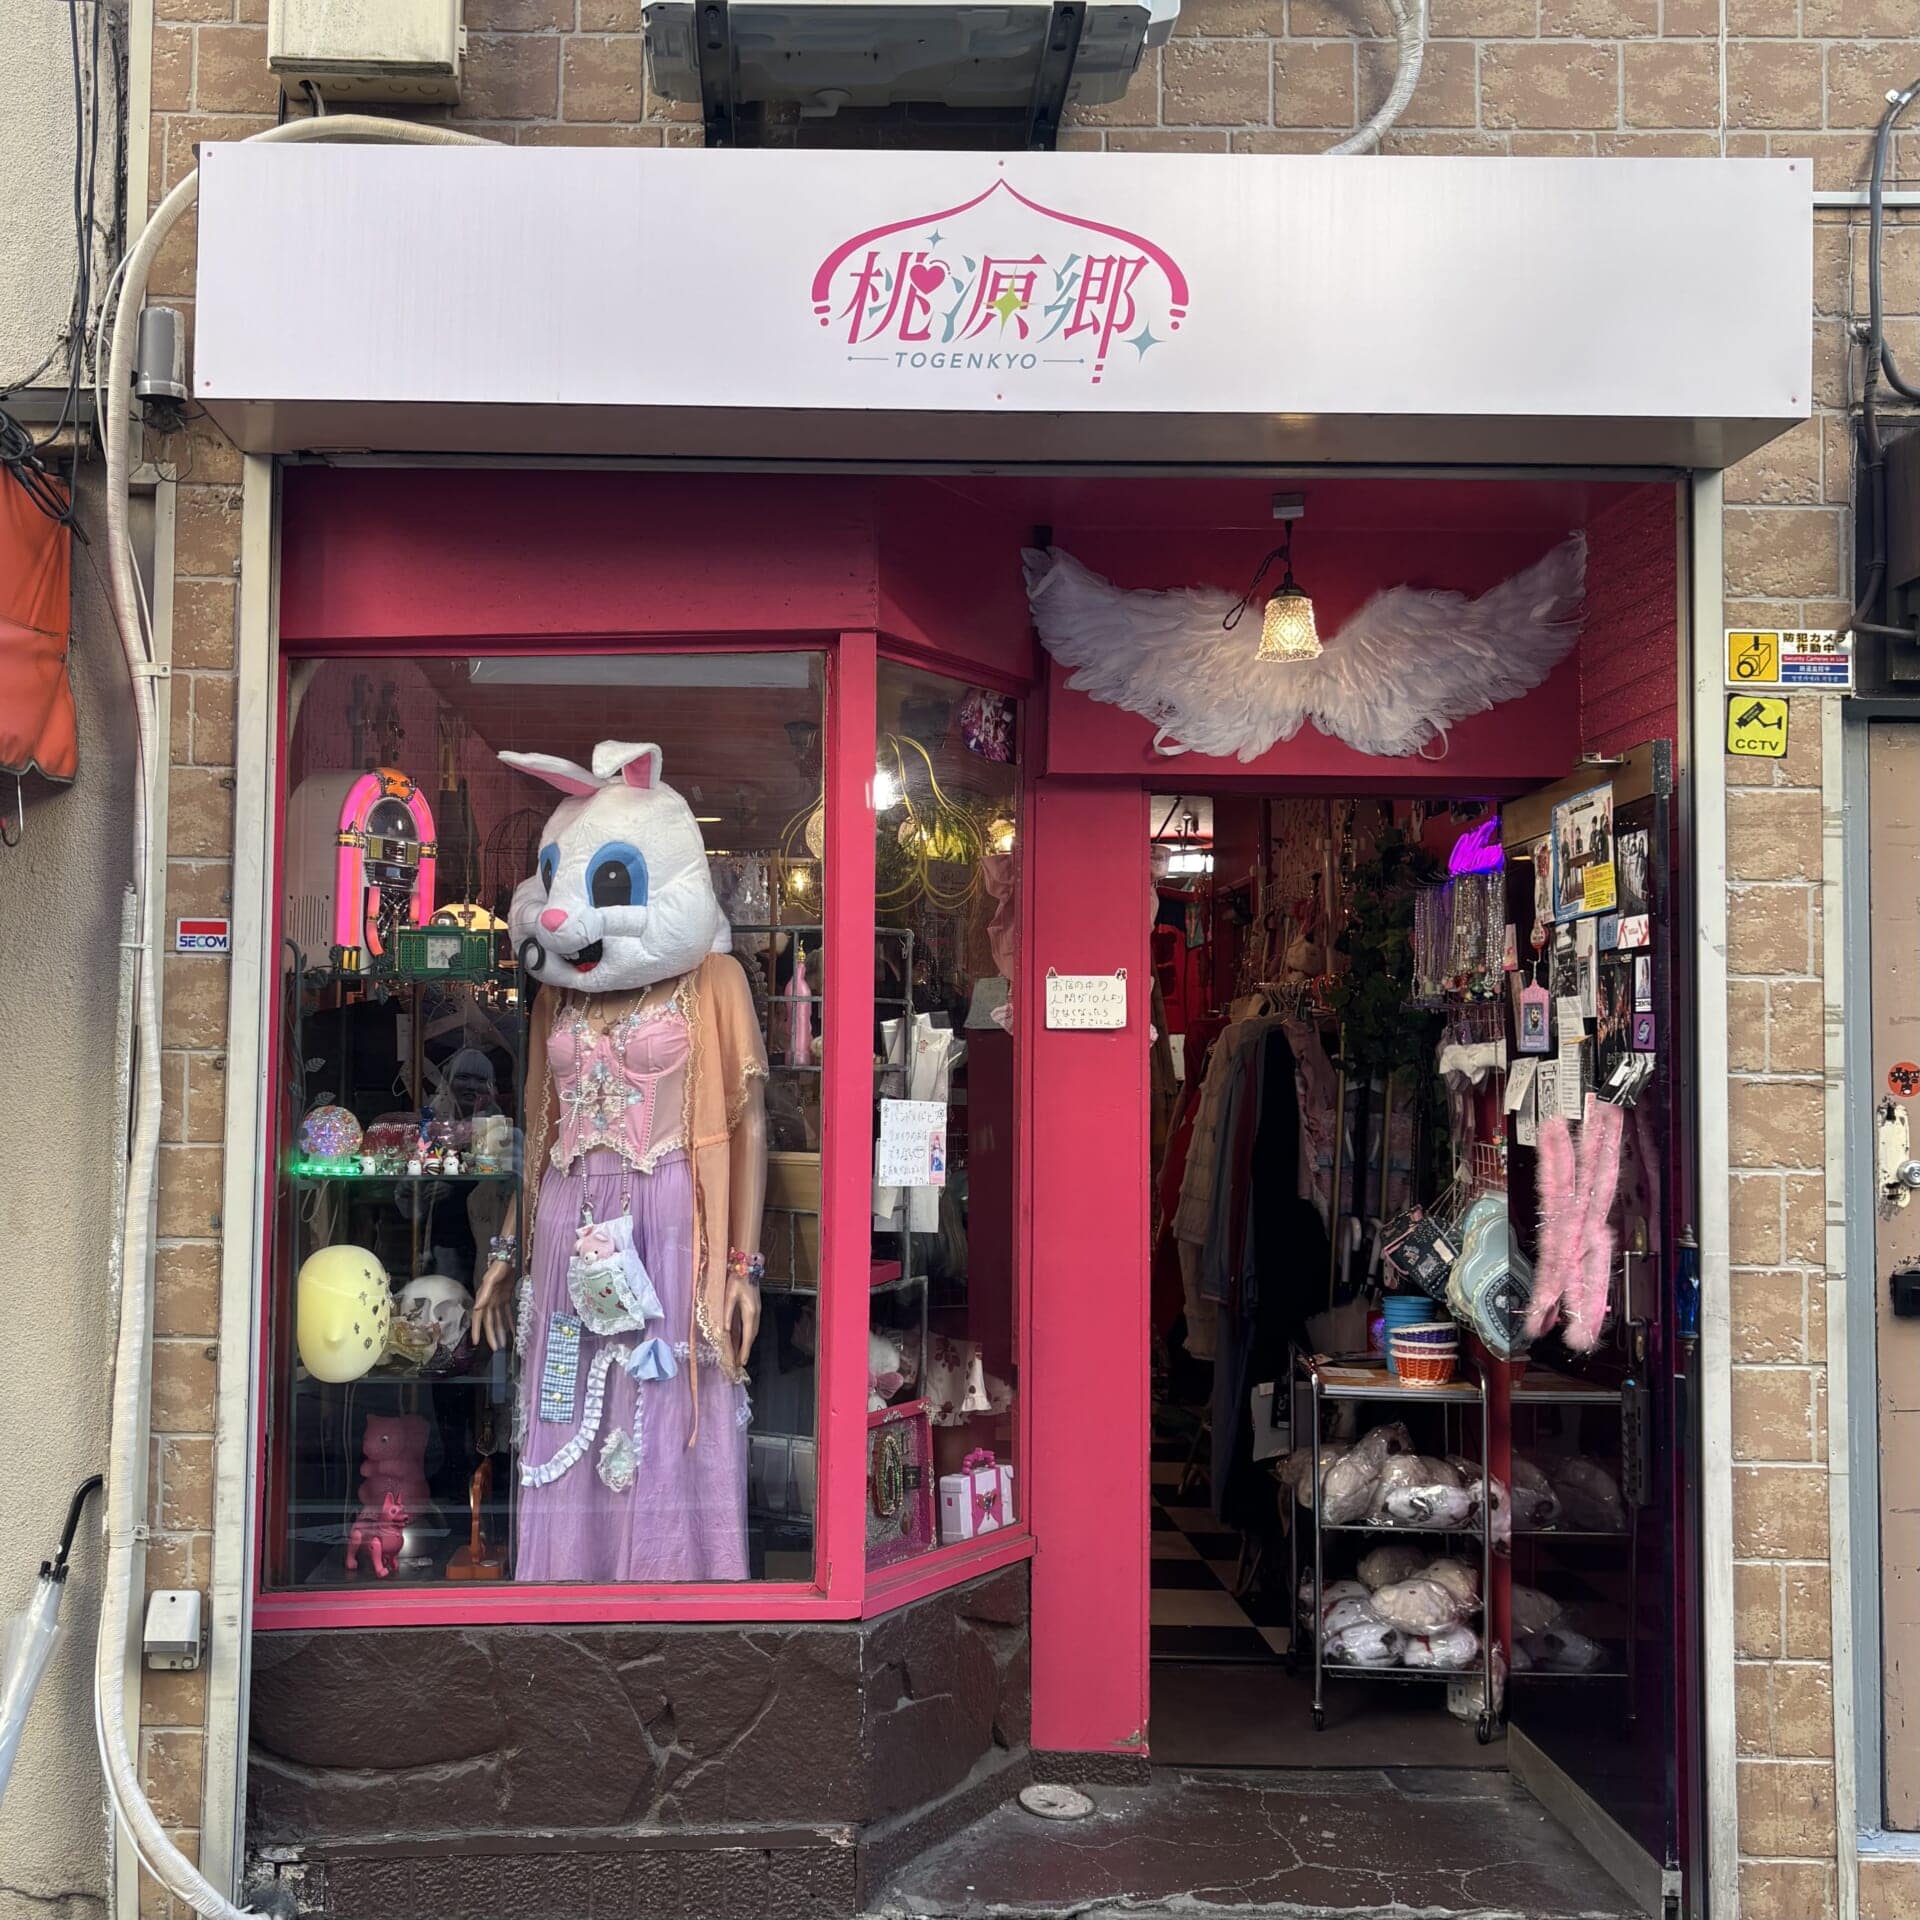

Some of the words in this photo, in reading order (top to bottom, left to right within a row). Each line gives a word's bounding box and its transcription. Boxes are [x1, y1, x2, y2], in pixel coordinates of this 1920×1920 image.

[836, 250, 1150, 360] 桃源郷
[894, 351, 1038, 370] TOGENKYO
[1782, 632, 1847, 644] 防犯カメラ
[1796, 643, 1835, 654] 作動中
[1735, 738, 1780, 751] CCTV
[179, 935, 227, 948] SECOM
